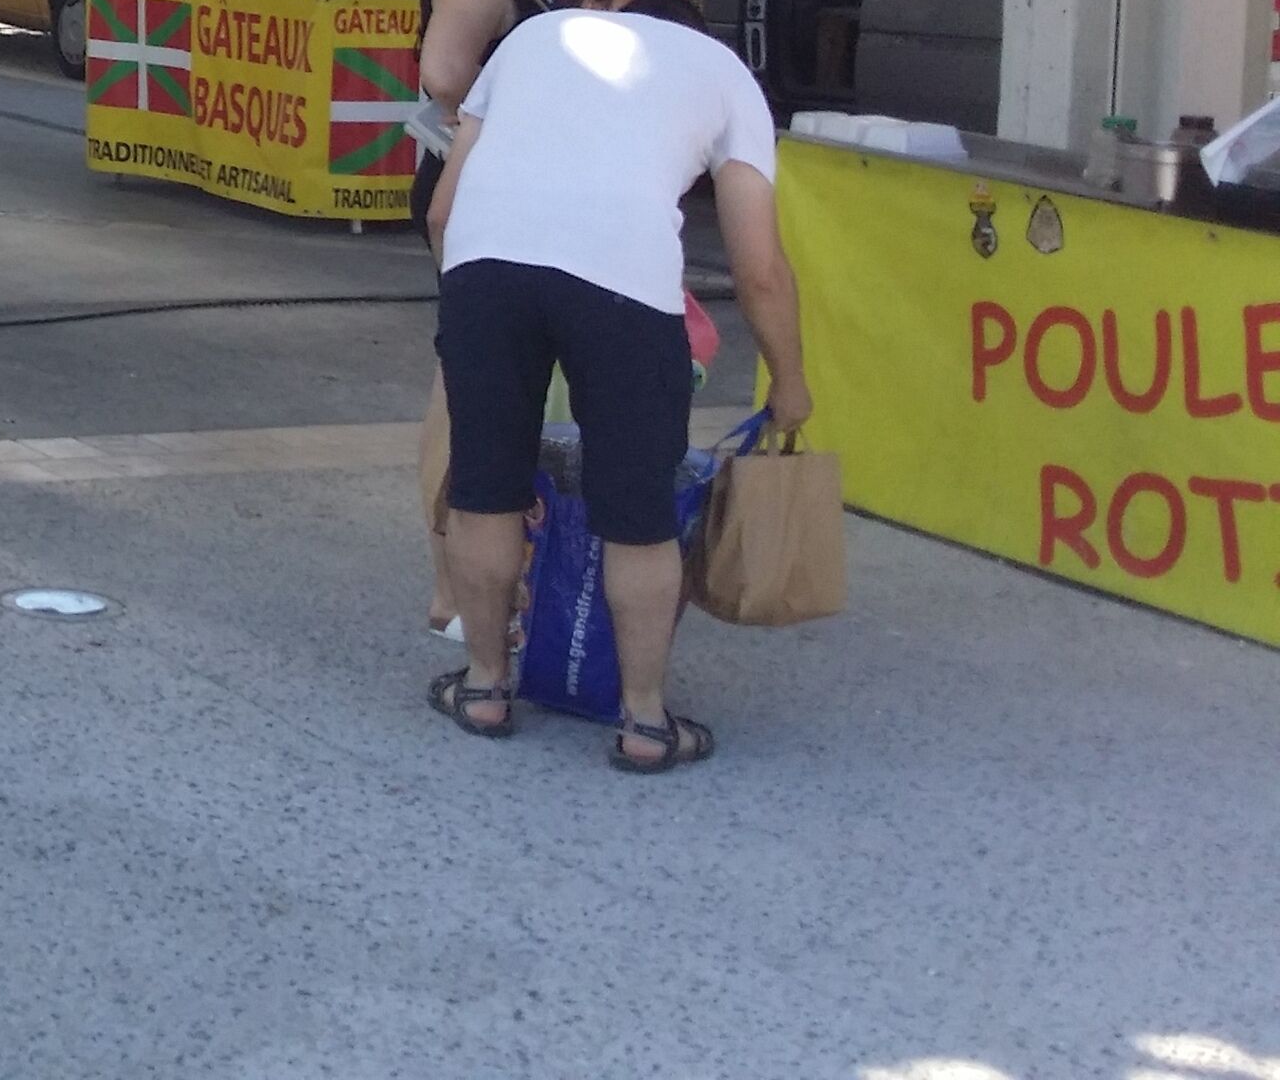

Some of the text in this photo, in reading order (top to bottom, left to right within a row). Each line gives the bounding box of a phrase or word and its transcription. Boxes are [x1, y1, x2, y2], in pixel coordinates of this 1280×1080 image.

[195, 76, 307, 149] BASQUES
[216, 164, 296, 204] ARTISANAL
[1040, 464, 1280, 584] ROT
